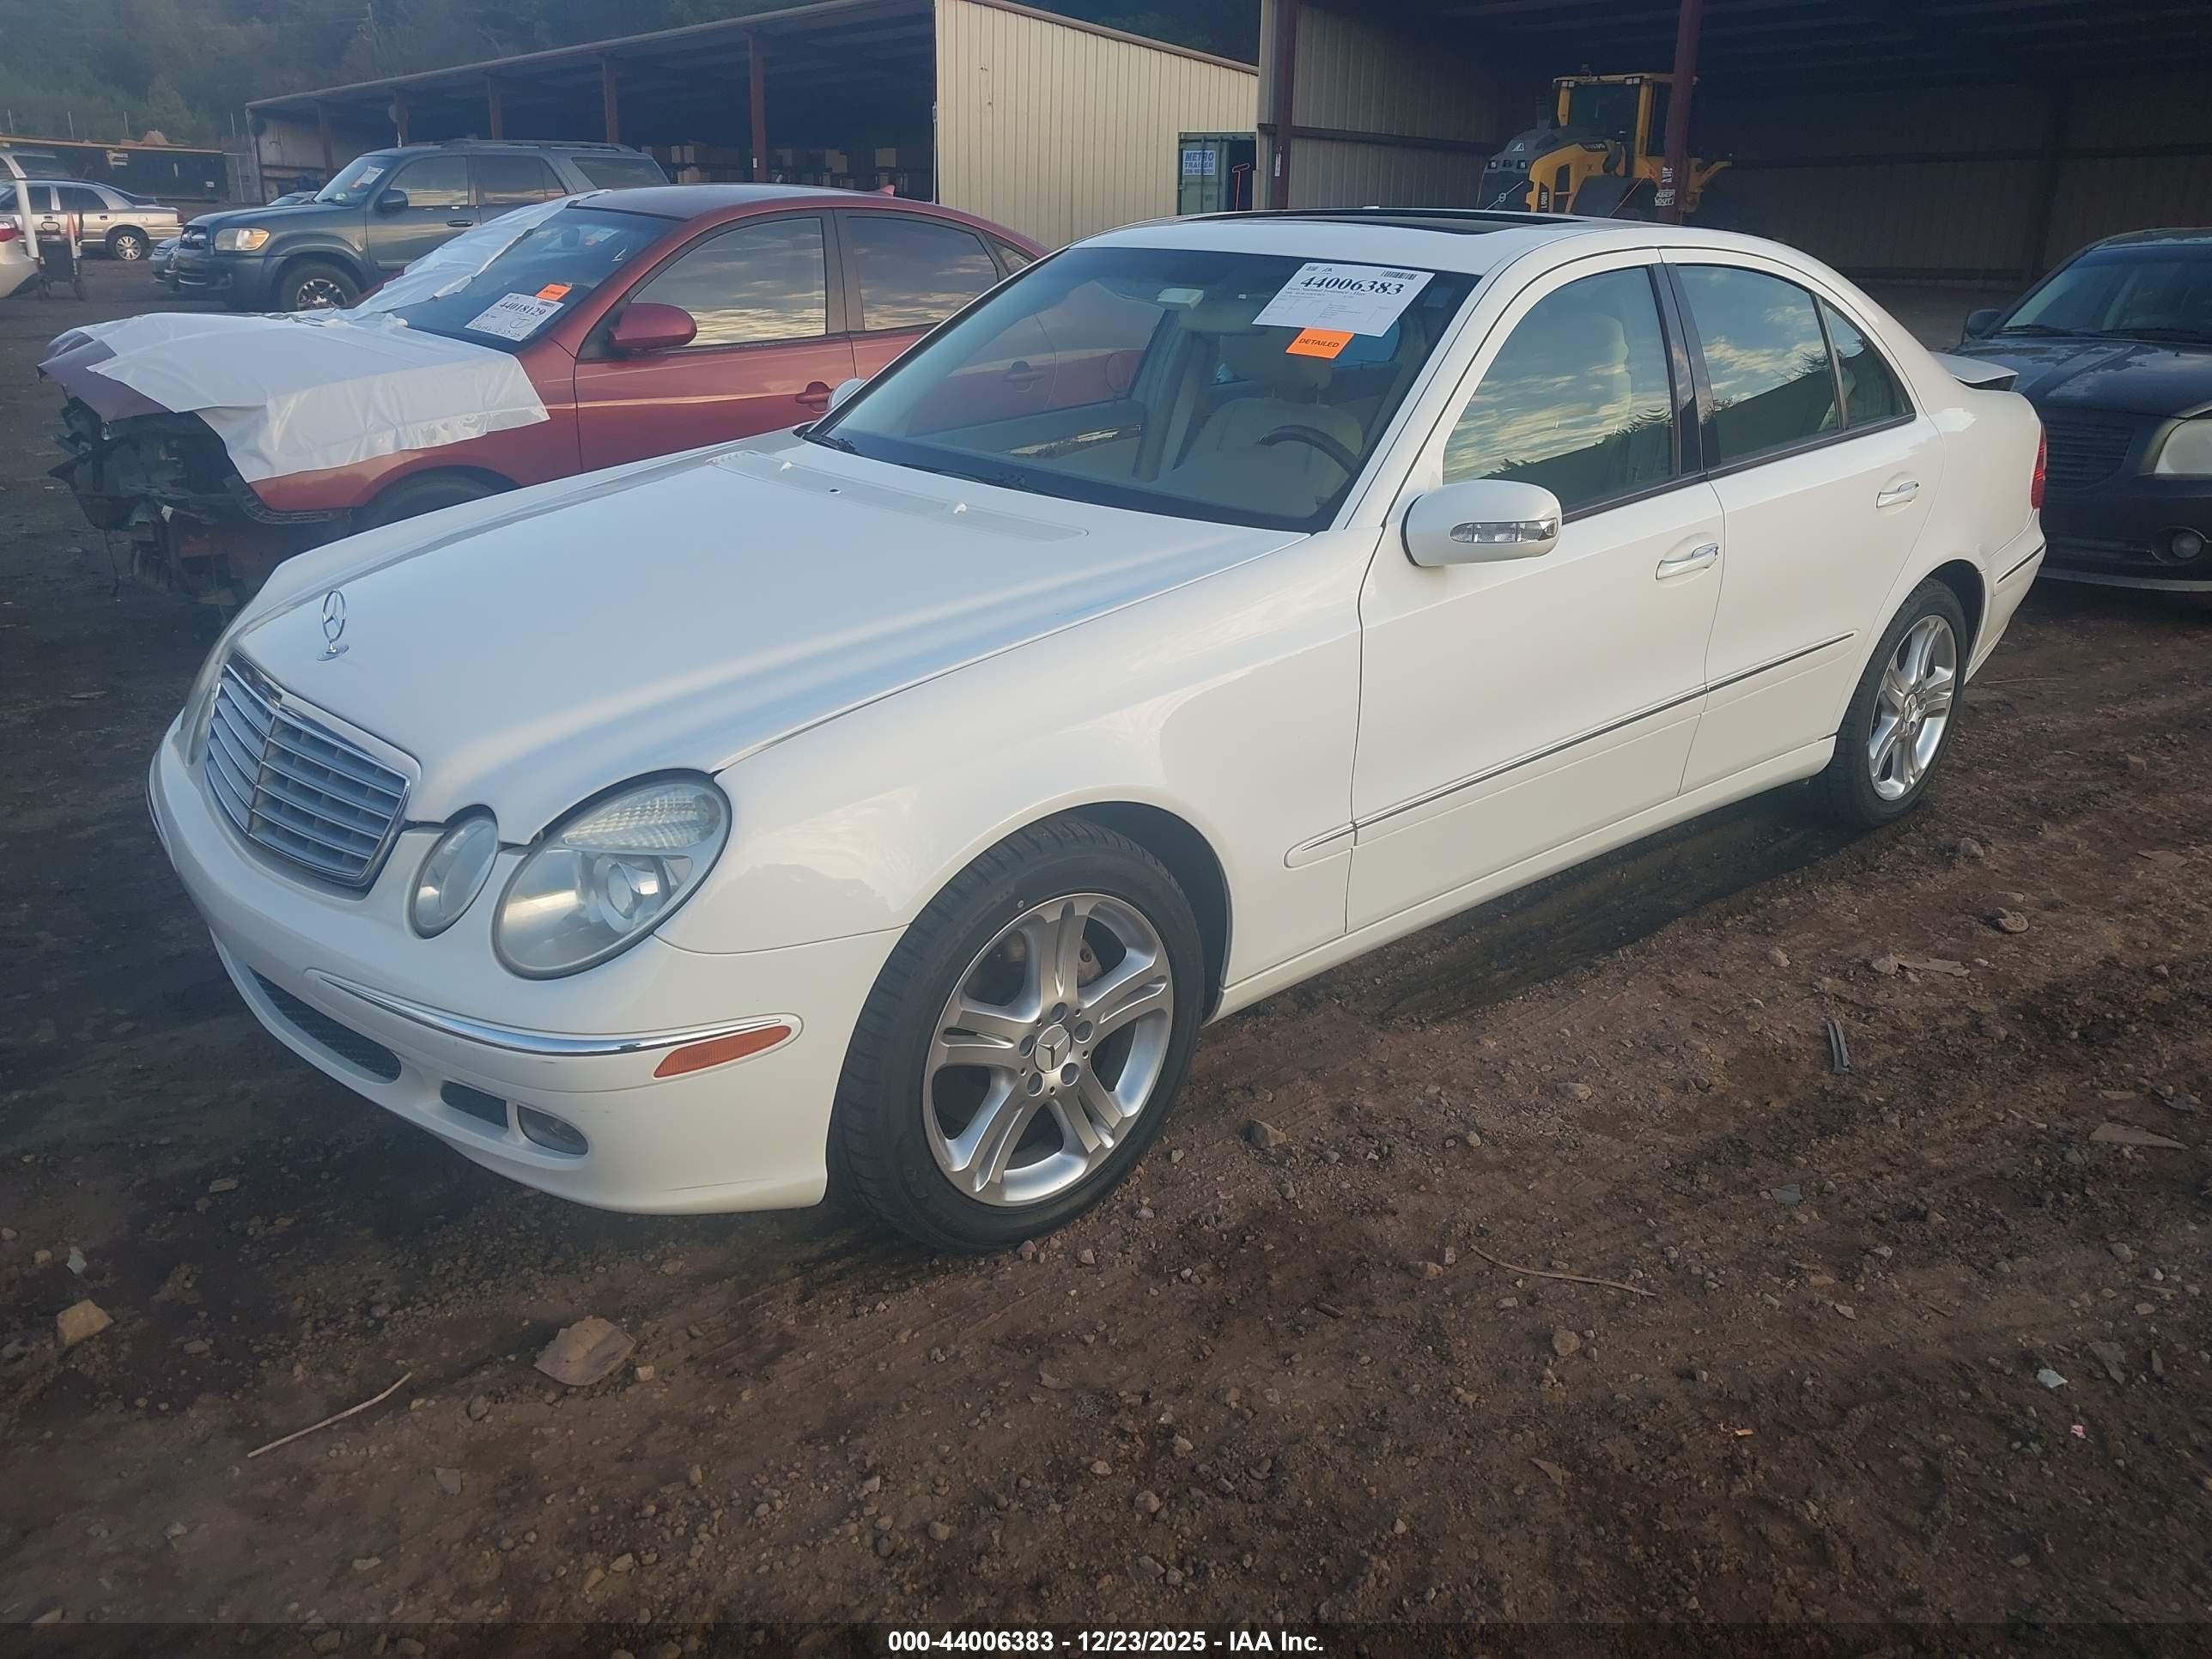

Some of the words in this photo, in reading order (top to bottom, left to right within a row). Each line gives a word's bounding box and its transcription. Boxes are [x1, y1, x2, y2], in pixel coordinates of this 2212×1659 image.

[1300, 276, 1405, 295] 44006383
[499, 301, 547, 317] 44018129
[1298, 337, 1340, 349] DETAILED
